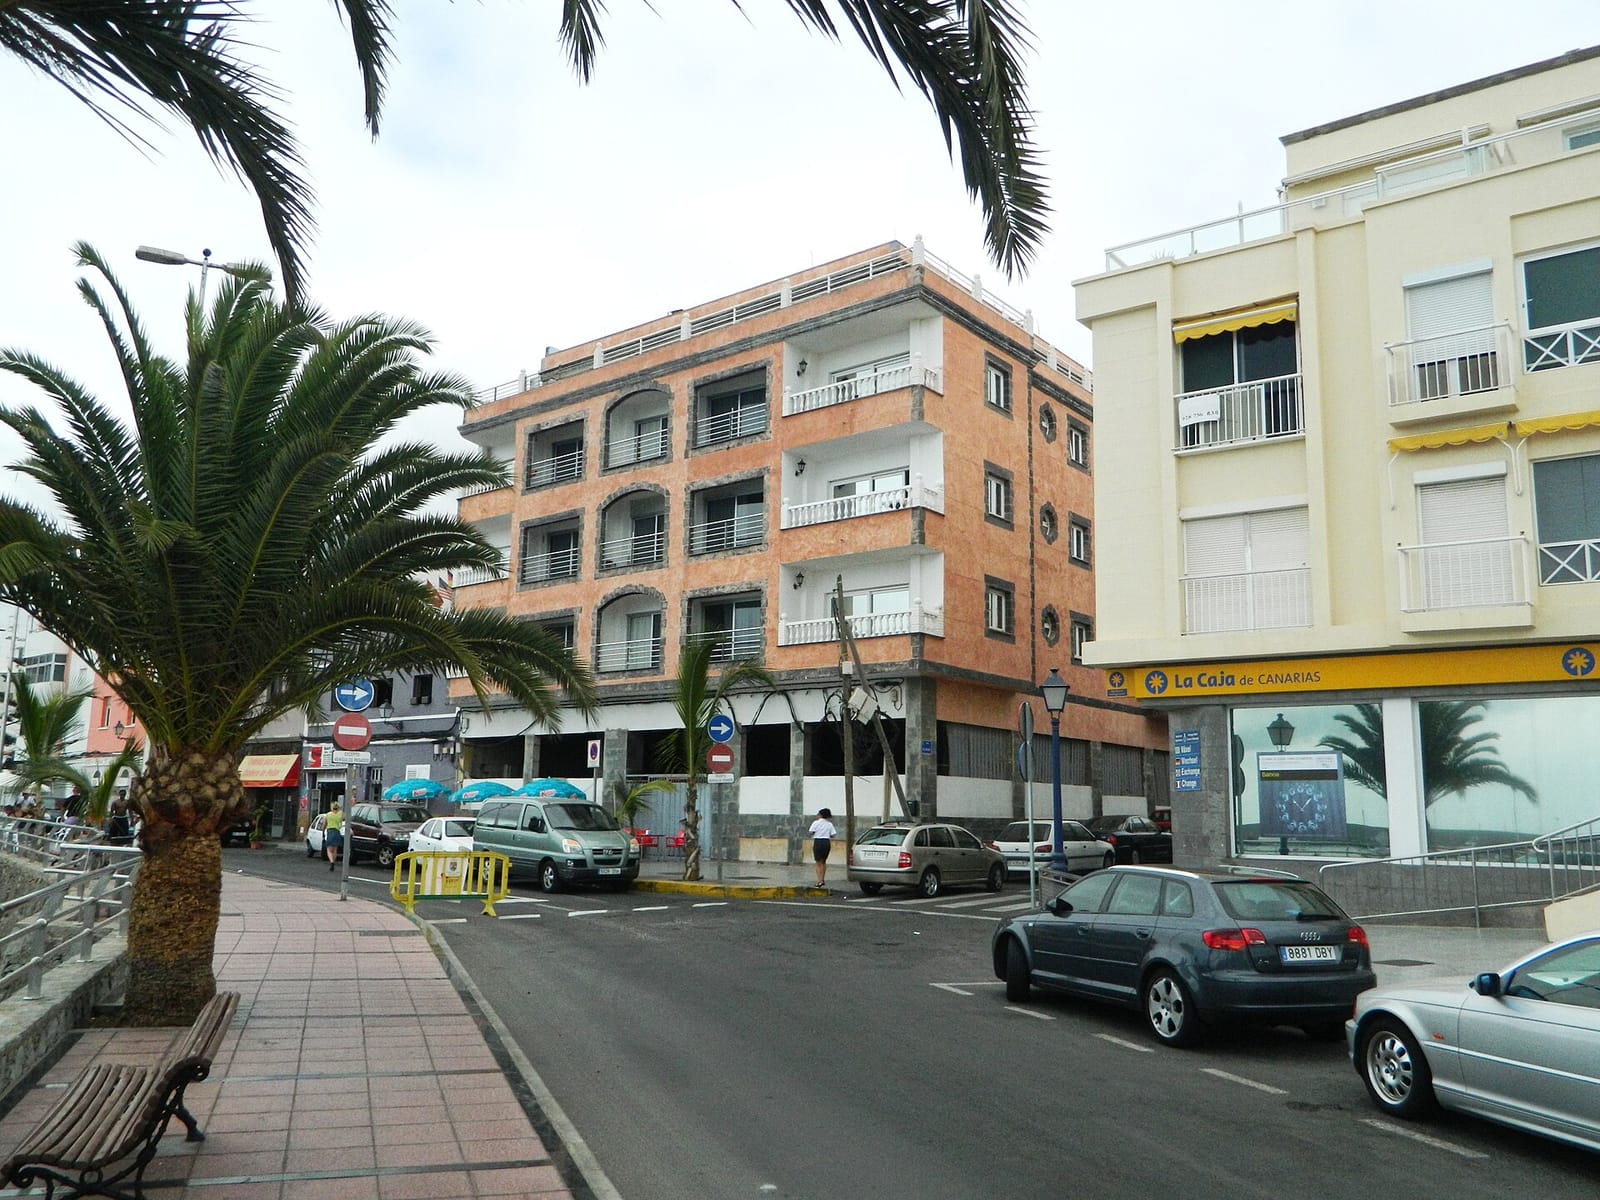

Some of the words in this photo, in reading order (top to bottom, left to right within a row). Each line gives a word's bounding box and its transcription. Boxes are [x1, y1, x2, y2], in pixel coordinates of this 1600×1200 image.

[1174, 674, 1193, 688] La
[1197, 671, 1235, 688] Caja
[1239, 675, 1254, 686] de
[1257, 671, 1321, 685] CANARIAS
[1181, 767, 1200, 777] Exchange
[1181, 779, 1197, 789] Change
[1288, 947, 1312, 959] 8881
[1315, 946, 1334, 959] DBY
